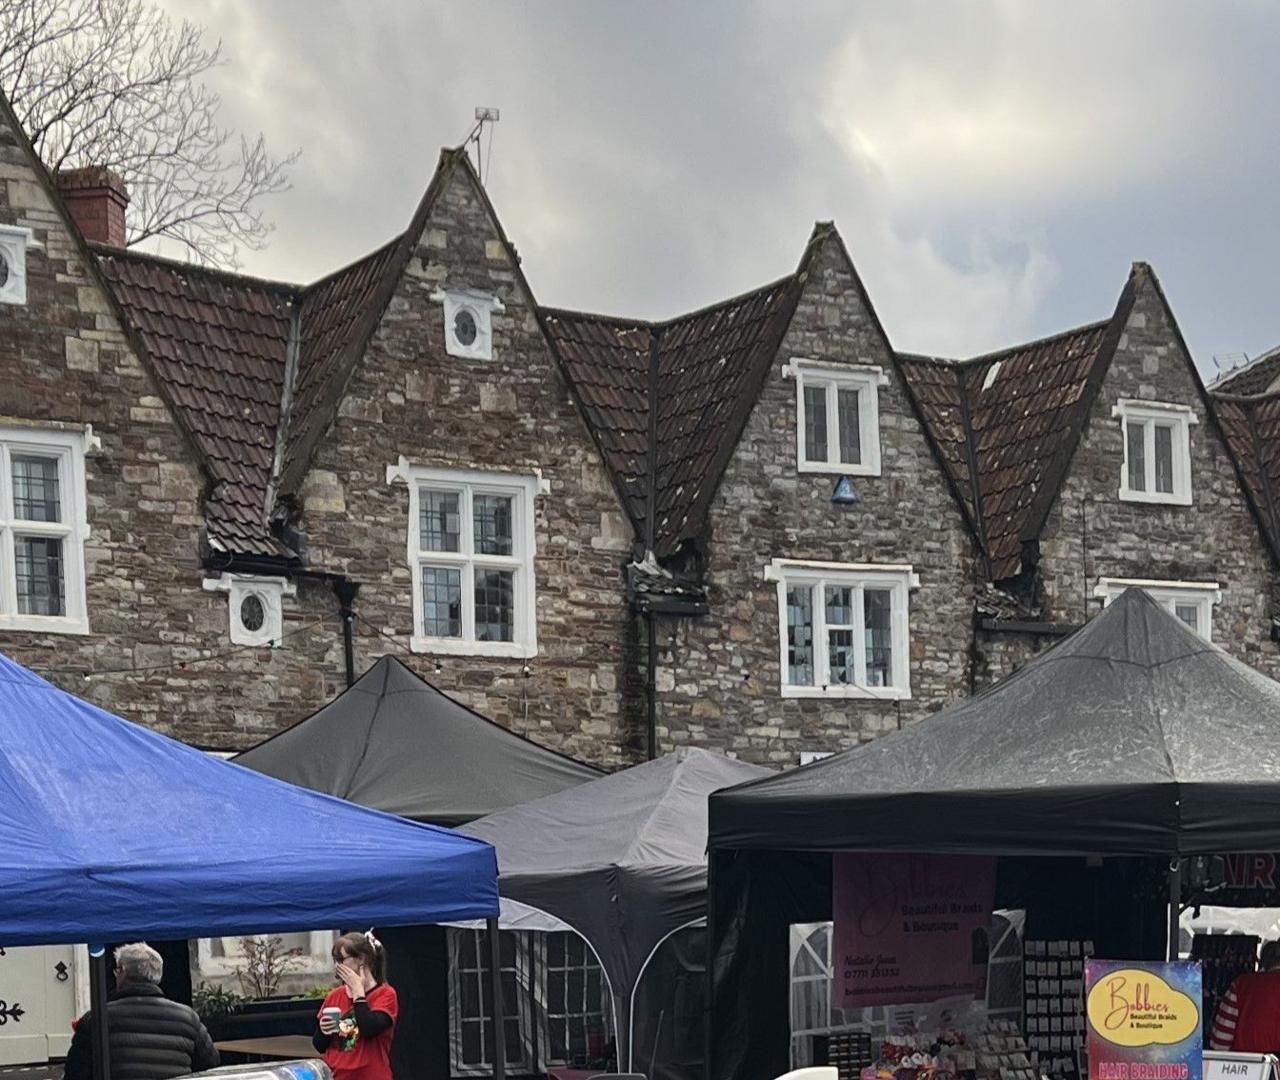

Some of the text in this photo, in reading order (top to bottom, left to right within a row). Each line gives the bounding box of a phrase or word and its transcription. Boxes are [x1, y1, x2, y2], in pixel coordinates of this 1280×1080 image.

[1104, 976, 1168, 1030] Bobbies
[1130, 1013, 1177, 1021] Beautiful Braids
[1098, 1062, 1188, 1080] HAIR BRAIDING
[1221, 1063, 1248, 1076] HAIR
